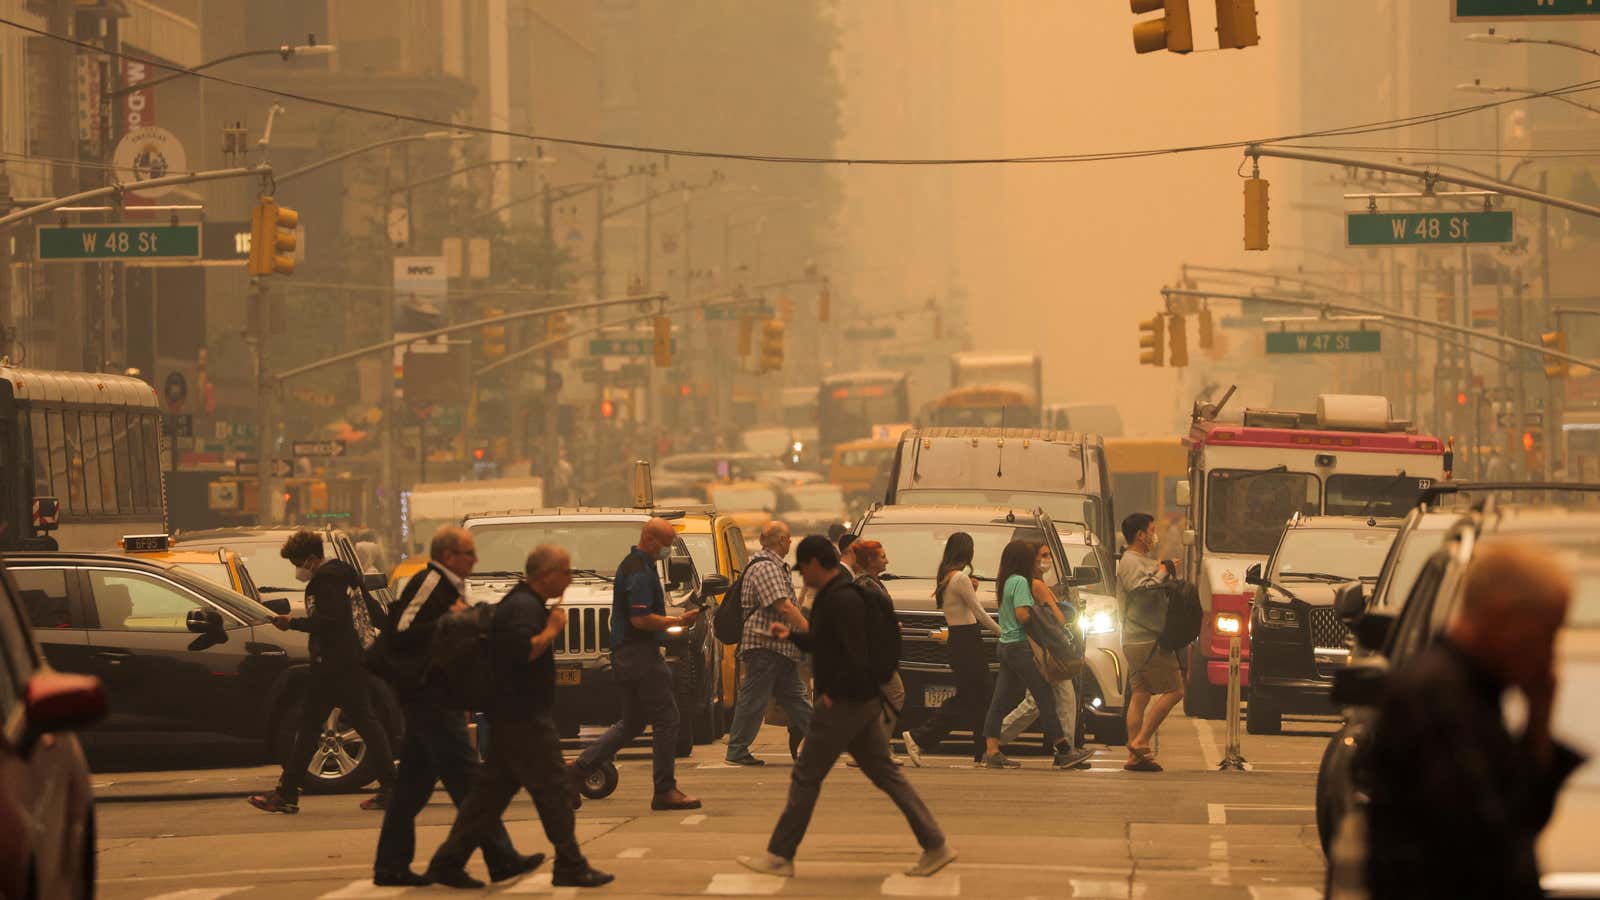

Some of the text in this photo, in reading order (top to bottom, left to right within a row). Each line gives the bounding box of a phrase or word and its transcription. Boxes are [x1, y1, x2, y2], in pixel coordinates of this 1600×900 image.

[1391, 217, 1470, 239] W 48 St
[82, 231, 158, 253] W 48 St
[1296, 335, 1350, 351] W 47 St
